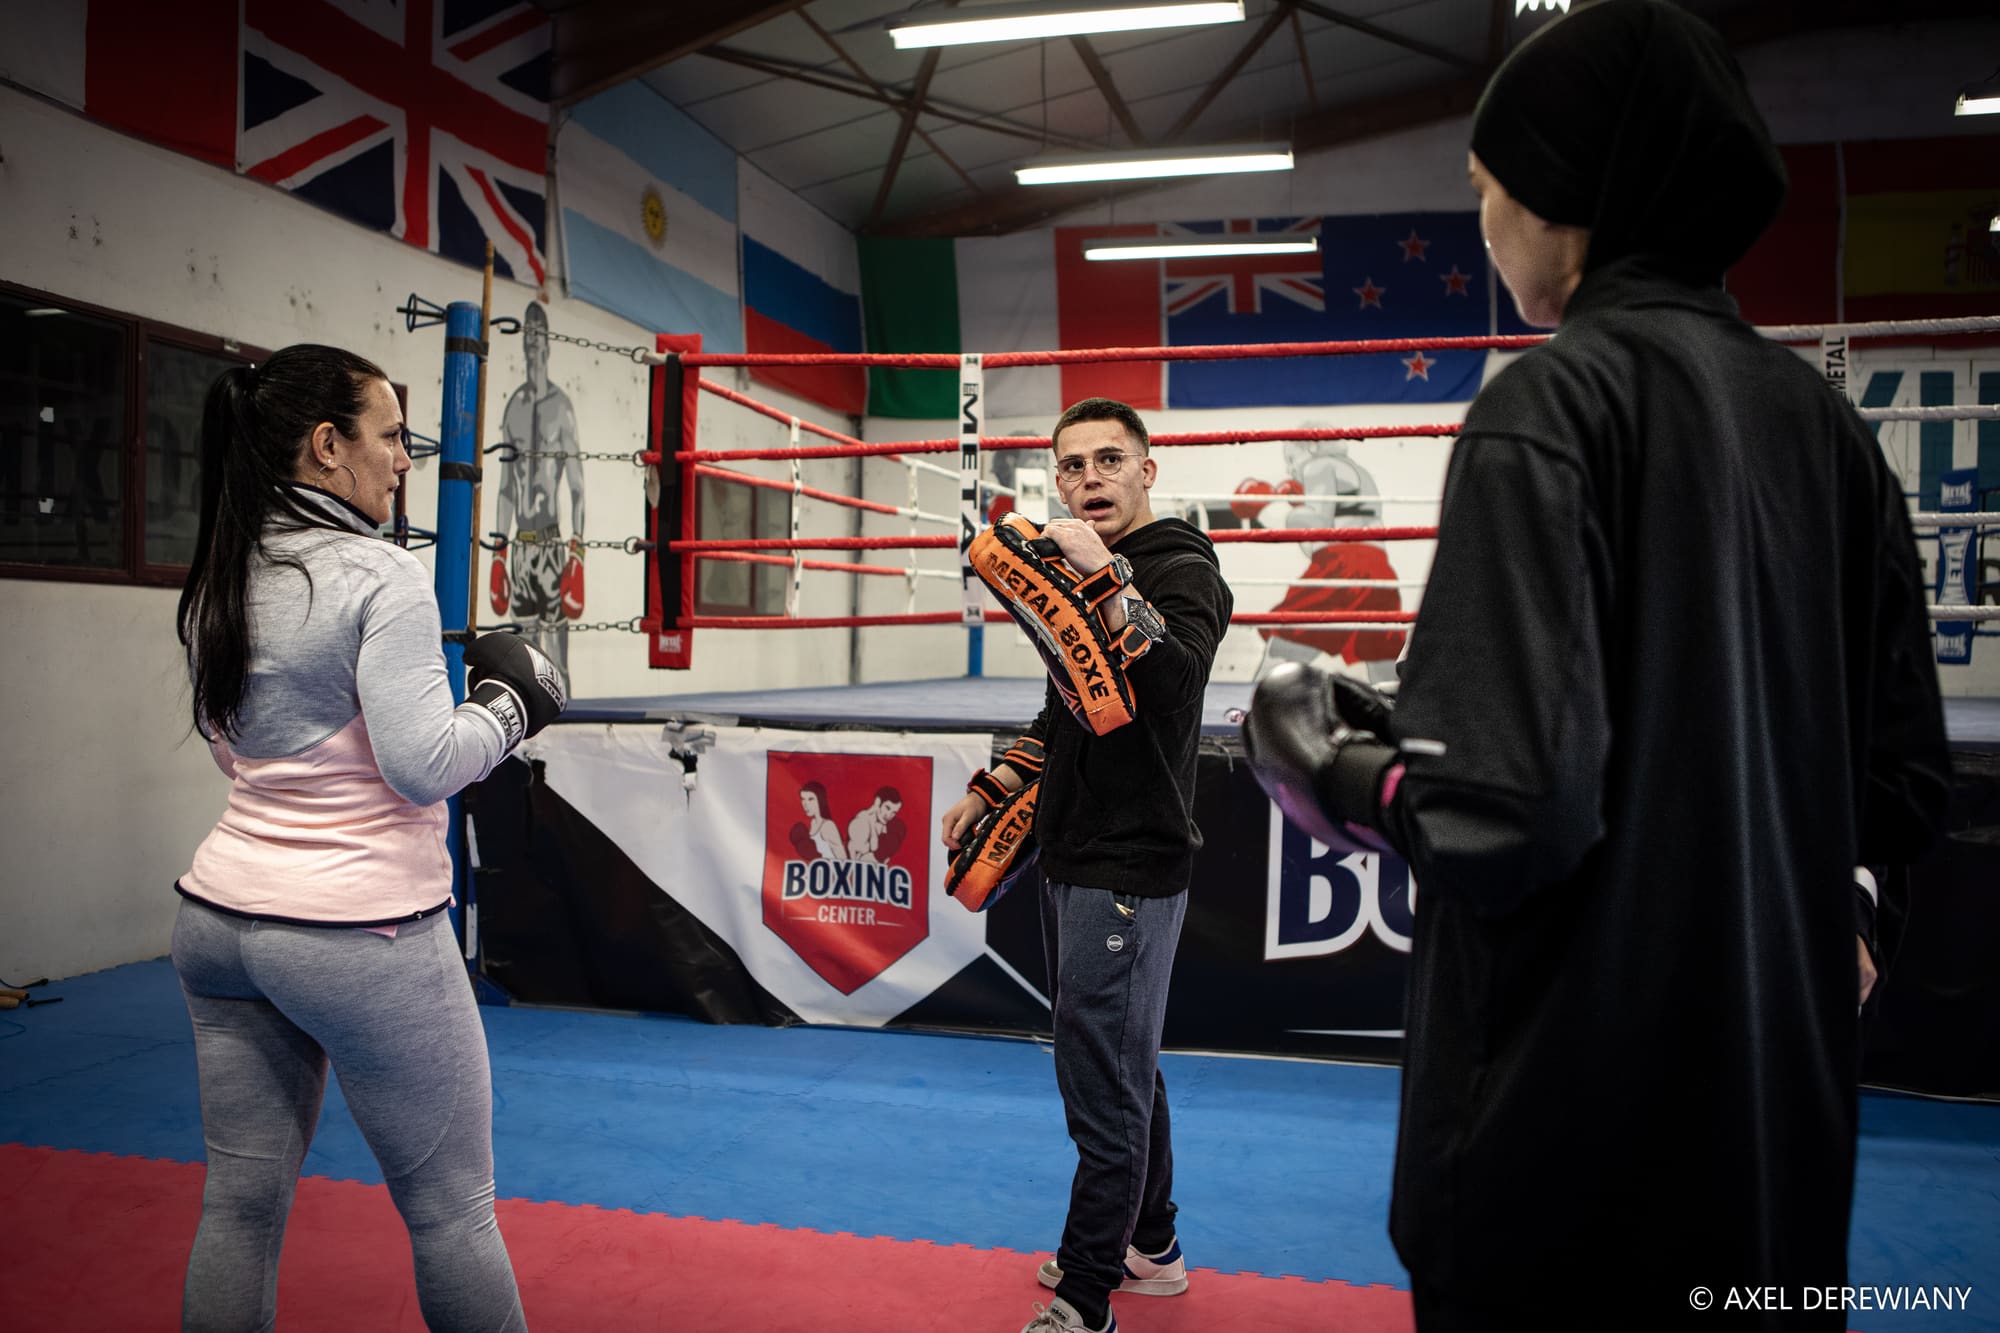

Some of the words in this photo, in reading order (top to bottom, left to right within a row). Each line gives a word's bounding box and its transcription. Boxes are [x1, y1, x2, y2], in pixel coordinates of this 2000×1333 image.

[961, 395, 979, 590] METAL
[984, 552, 1060, 627] METAL
[1060, 624, 1109, 700] BOXE
[783, 859, 911, 908] BOXING
[818, 905, 876, 926] CENTER
